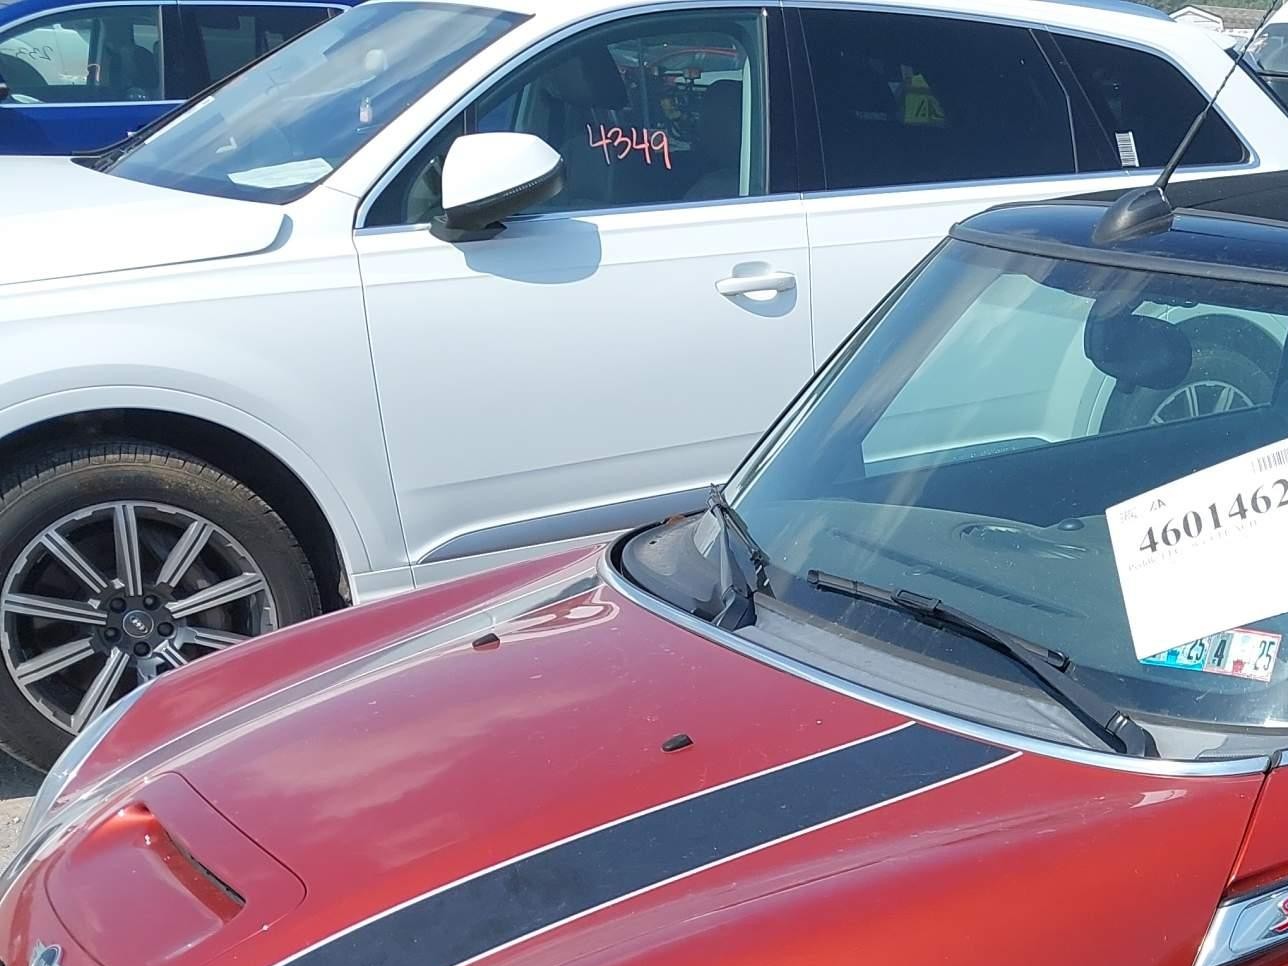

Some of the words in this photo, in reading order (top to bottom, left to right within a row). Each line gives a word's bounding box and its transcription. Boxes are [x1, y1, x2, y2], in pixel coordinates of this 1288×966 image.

[587, 124, 671, 169] 4349
[1212, 639, 1228, 667] 4
[1254, 640, 1276, 671] 25
